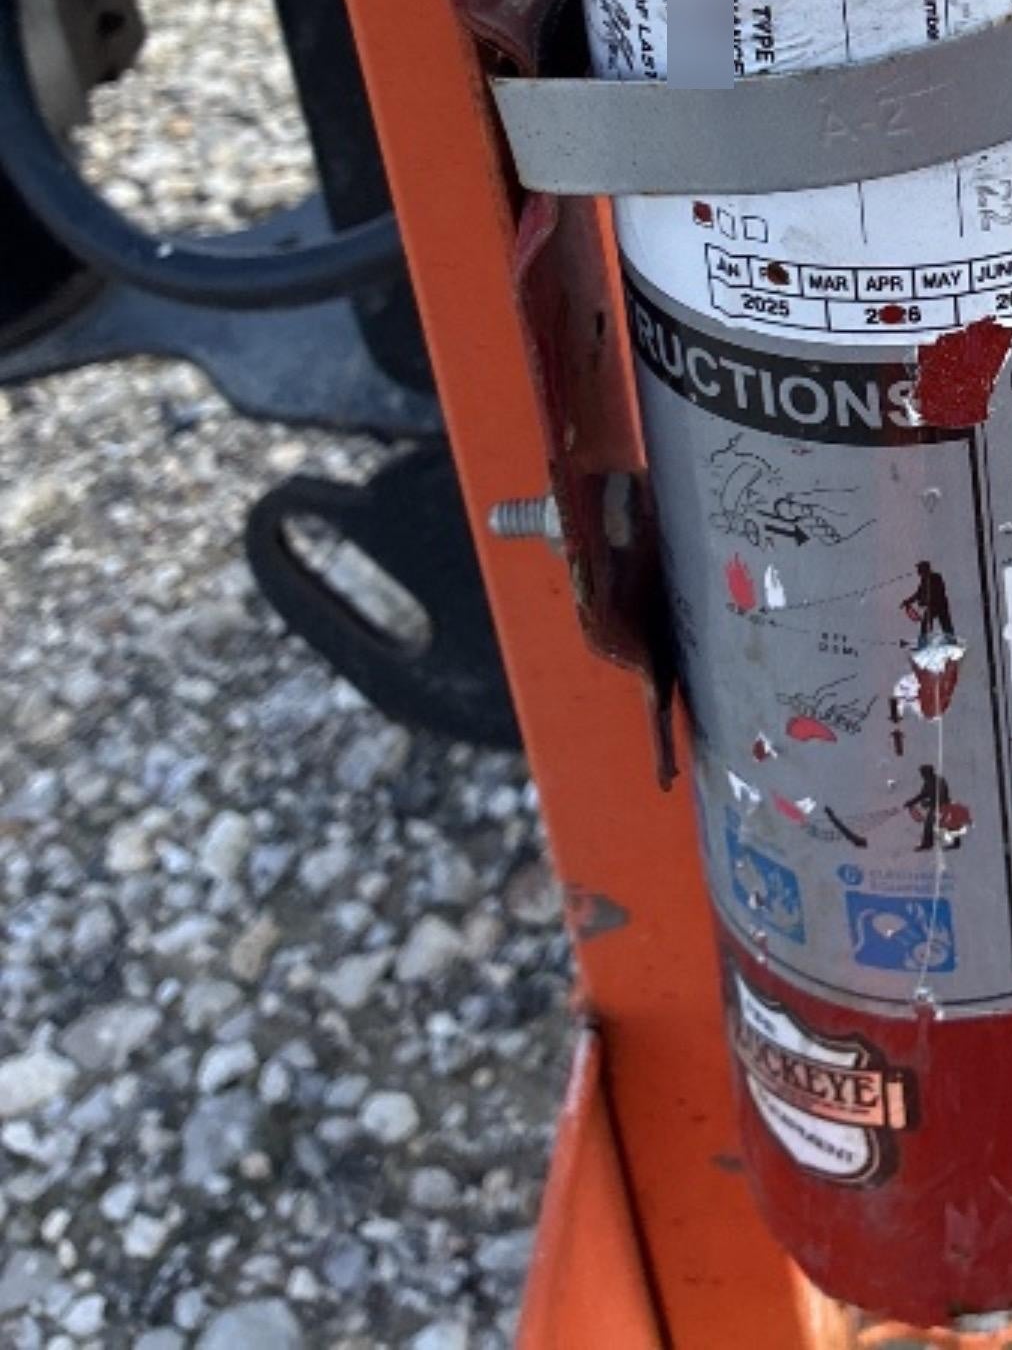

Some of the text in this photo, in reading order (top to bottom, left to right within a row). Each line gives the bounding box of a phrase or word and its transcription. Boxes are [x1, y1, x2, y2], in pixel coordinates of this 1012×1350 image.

[752, 6, 775, 63] TYPE
[808, 273, 849, 291] MAR
[866, 275, 904, 293] APR
[923, 270, 963, 289] MAY
[741, 293, 790, 317] 2025
[865, 305, 921, 325] 26
